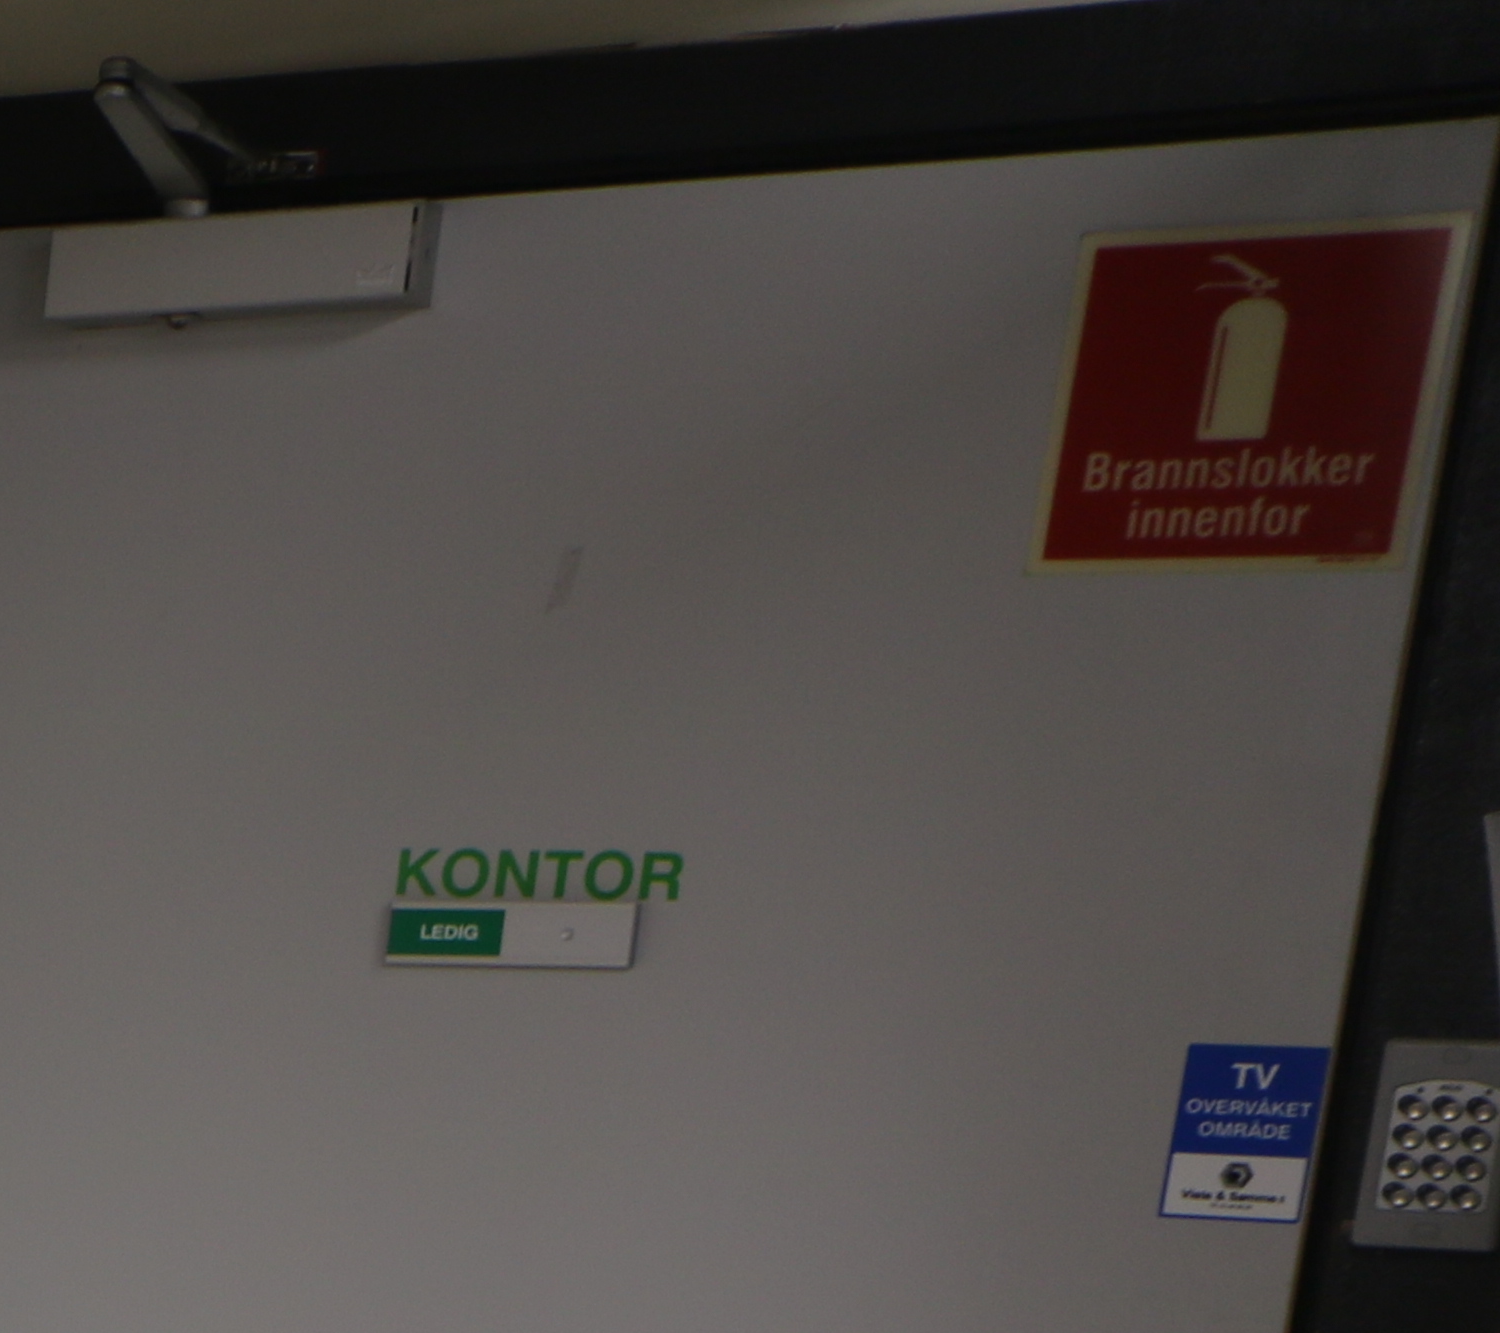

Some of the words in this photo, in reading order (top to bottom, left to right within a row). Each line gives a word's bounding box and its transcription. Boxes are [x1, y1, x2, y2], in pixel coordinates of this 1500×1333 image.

[1083, 446, 1375, 492] Brannslokker
[1126, 497, 1310, 540] innenfor
[396, 848, 685, 900] KONTOR
[420, 923, 479, 940] LEDIG
[1231, 1062, 1280, 1090] TV
[1185, 1097, 1312, 1119] OVERVÅKET
[1197, 1120, 1292, 1141] OMRÅDE
